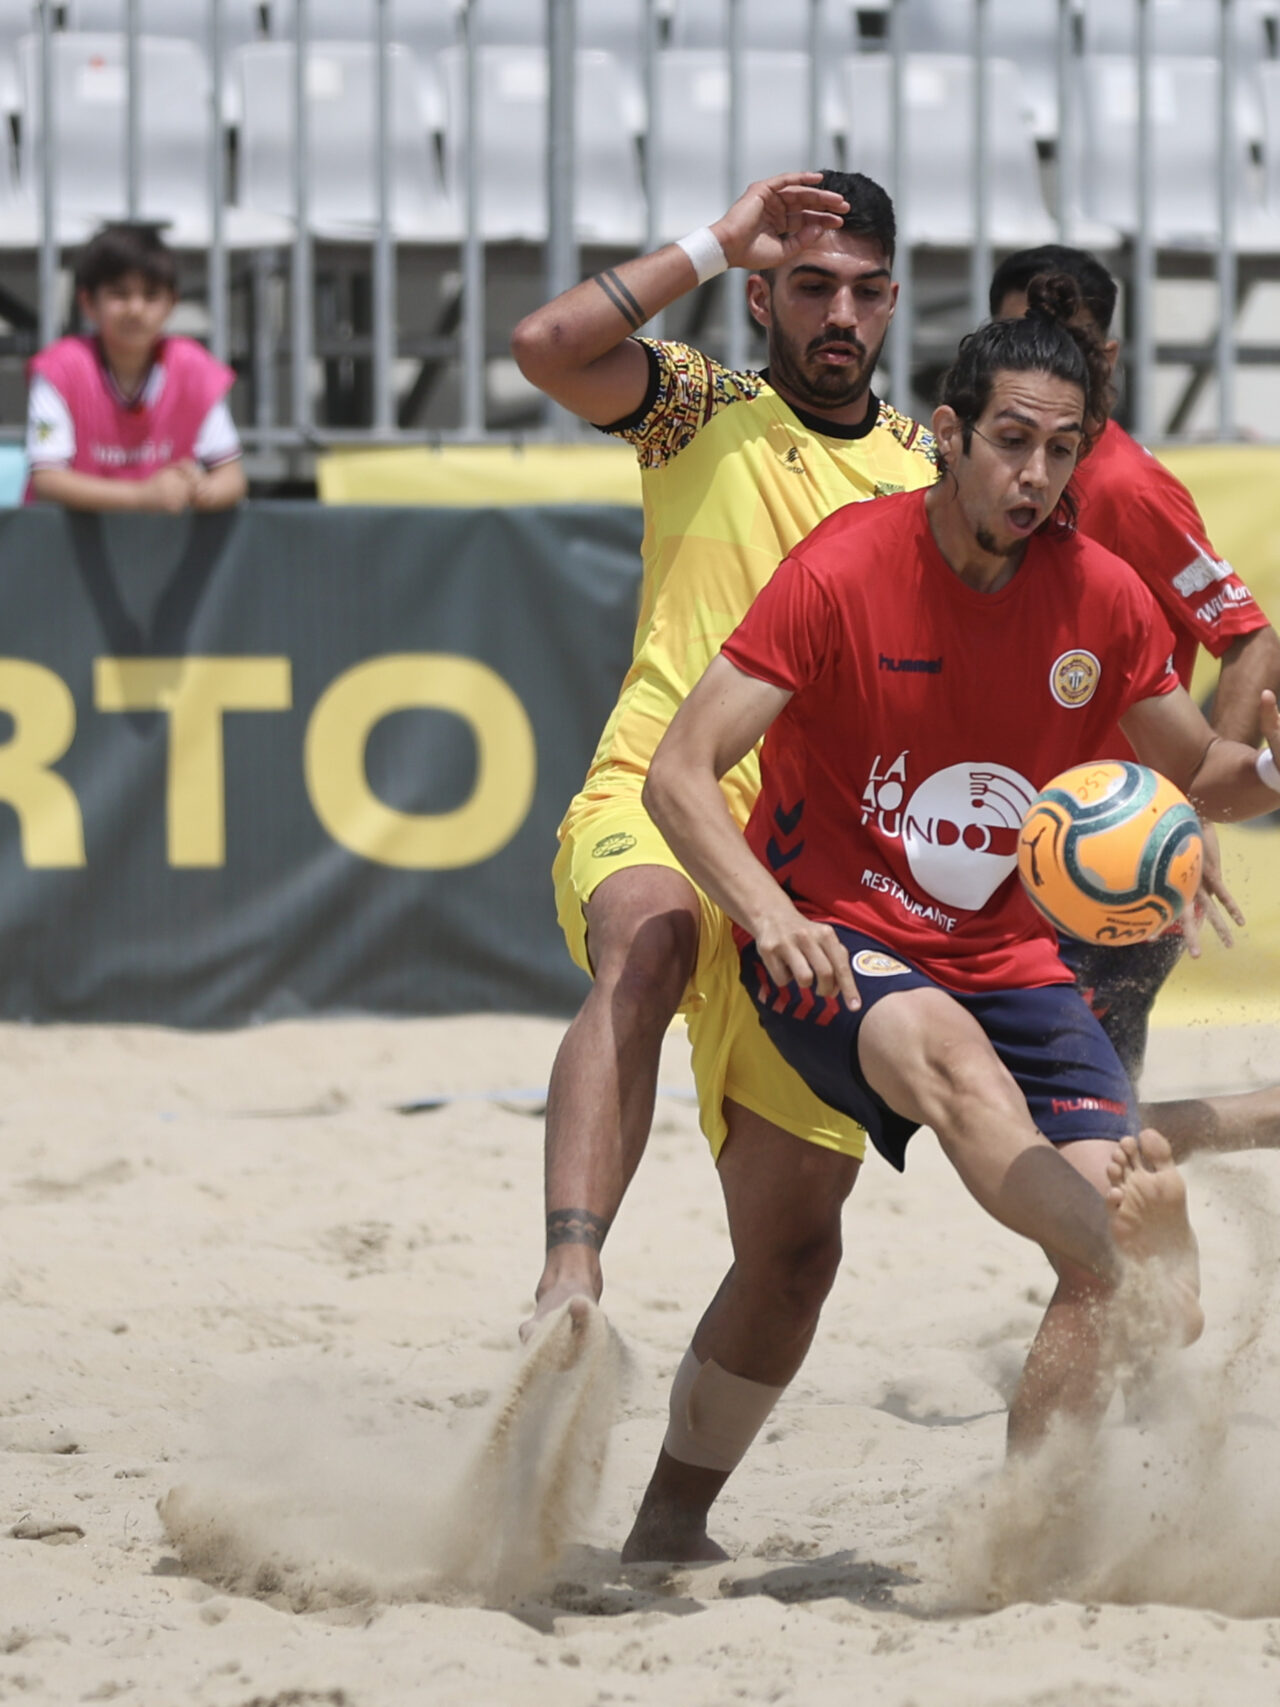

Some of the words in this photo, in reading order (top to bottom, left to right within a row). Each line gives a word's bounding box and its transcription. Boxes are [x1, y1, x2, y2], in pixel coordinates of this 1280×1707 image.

[878, 653, 943, 674] hummel
[869, 750, 910, 783] LÁ
[862, 780, 904, 811] AO
[861, 869, 957, 932] RESTAURANTE
